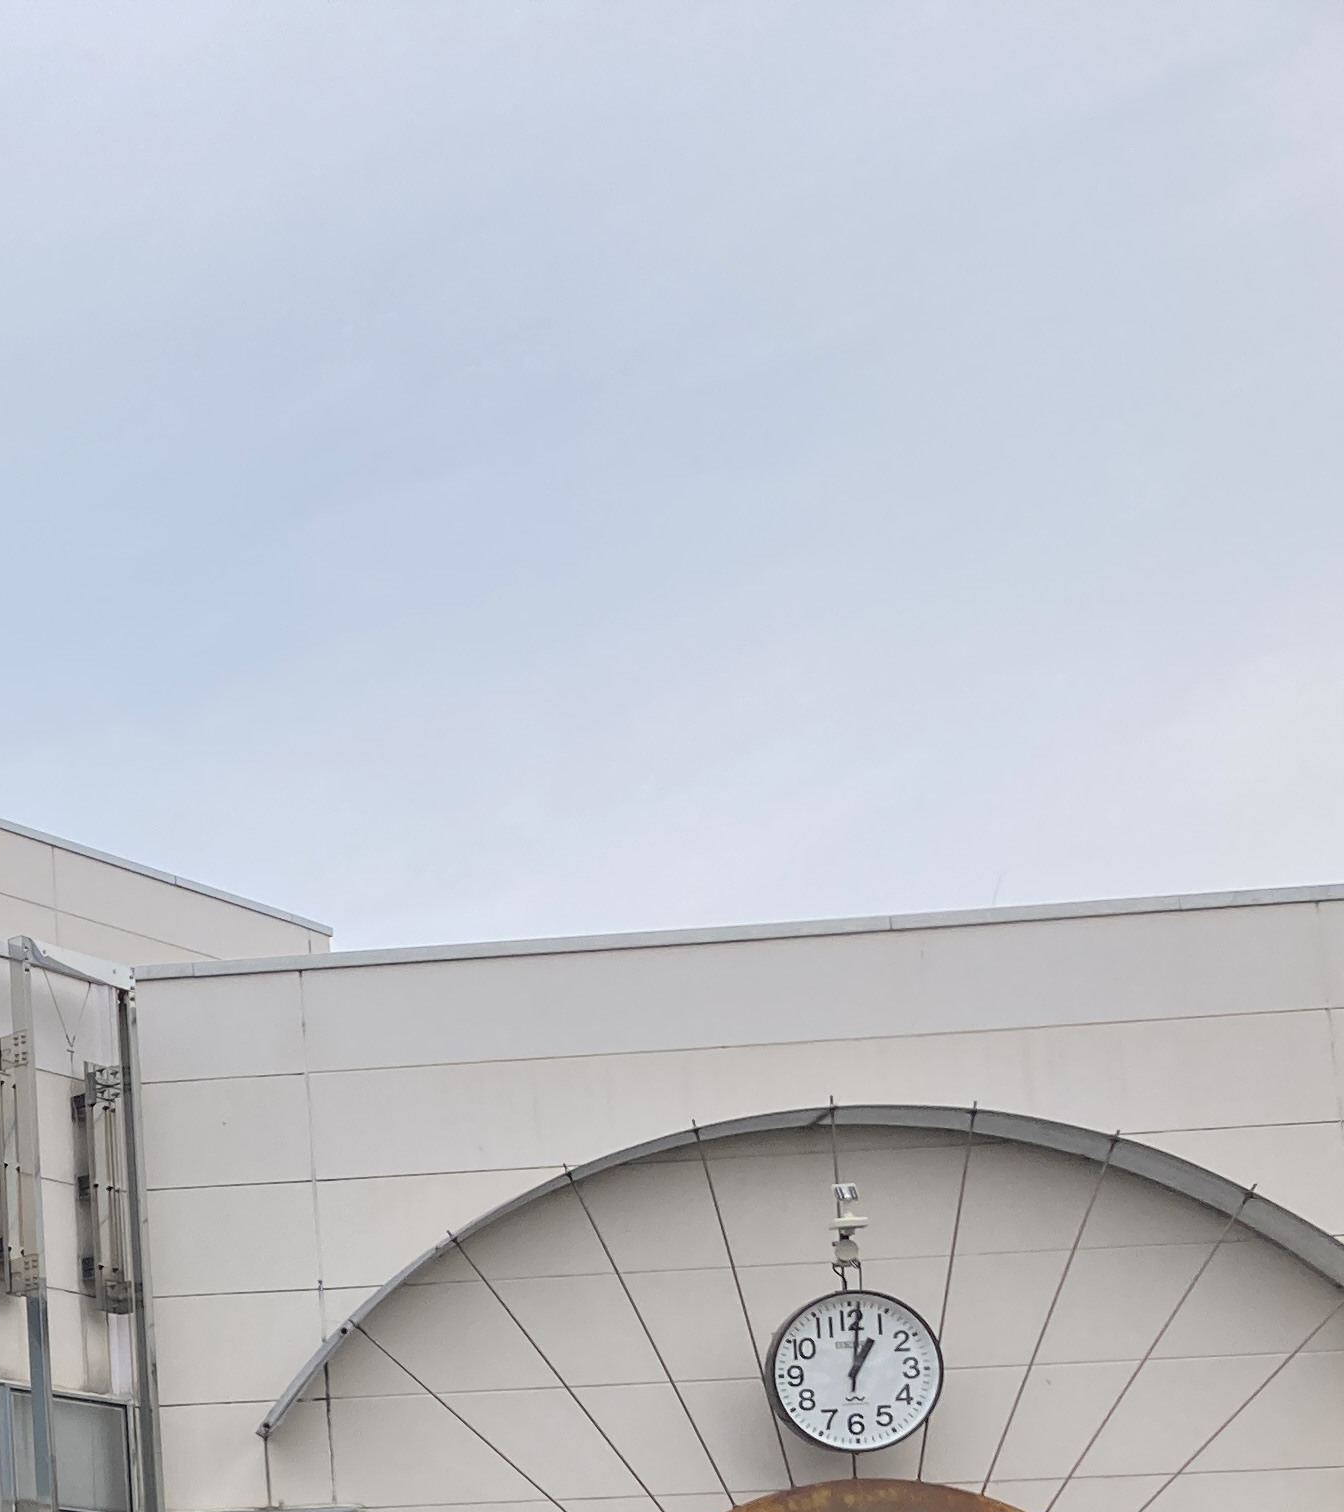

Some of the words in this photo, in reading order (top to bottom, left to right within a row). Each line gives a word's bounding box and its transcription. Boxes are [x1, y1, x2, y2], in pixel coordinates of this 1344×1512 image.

[816, 1317, 833, 1338] 11
[840, 1309, 864, 1331] 12
[877, 1313, 883, 1335] 1
[793, 1338, 815, 1360] 10
[893, 1330, 910, 1352] 2
[787, 1365, 804, 1387] 9
[903, 1357, 920, 1379] 3
[798, 1389, 815, 1411] 8
[896, 1384, 913, 1405] 4
[821, 1409, 838, 1430] 7
[848, 1413, 864, 1435] 6
[876, 1405, 893, 1426] 5
